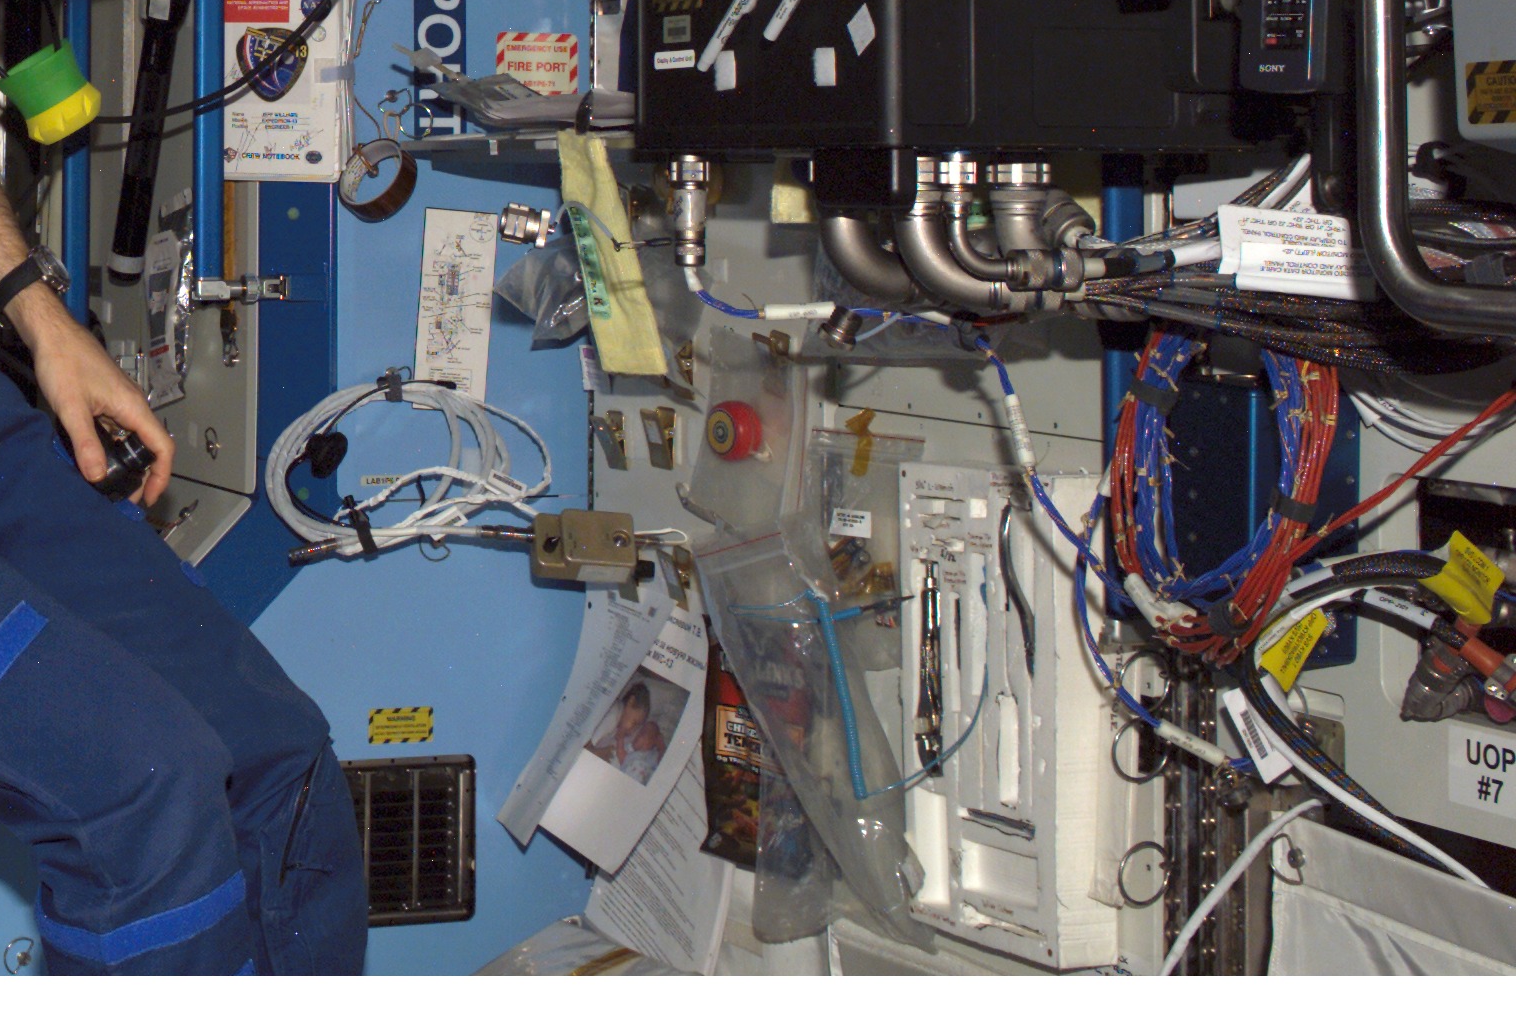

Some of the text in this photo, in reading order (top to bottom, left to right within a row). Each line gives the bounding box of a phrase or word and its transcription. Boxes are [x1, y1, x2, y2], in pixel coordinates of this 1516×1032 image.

[506, 44, 568, 53] EMERGENCY USE
[507, 62, 568, 73] FIRE PORT
[1259, 64, 1286, 73] SONY
[1466, 738, 1516, 772] UOP
[1477, 775, 1504, 804] #7
